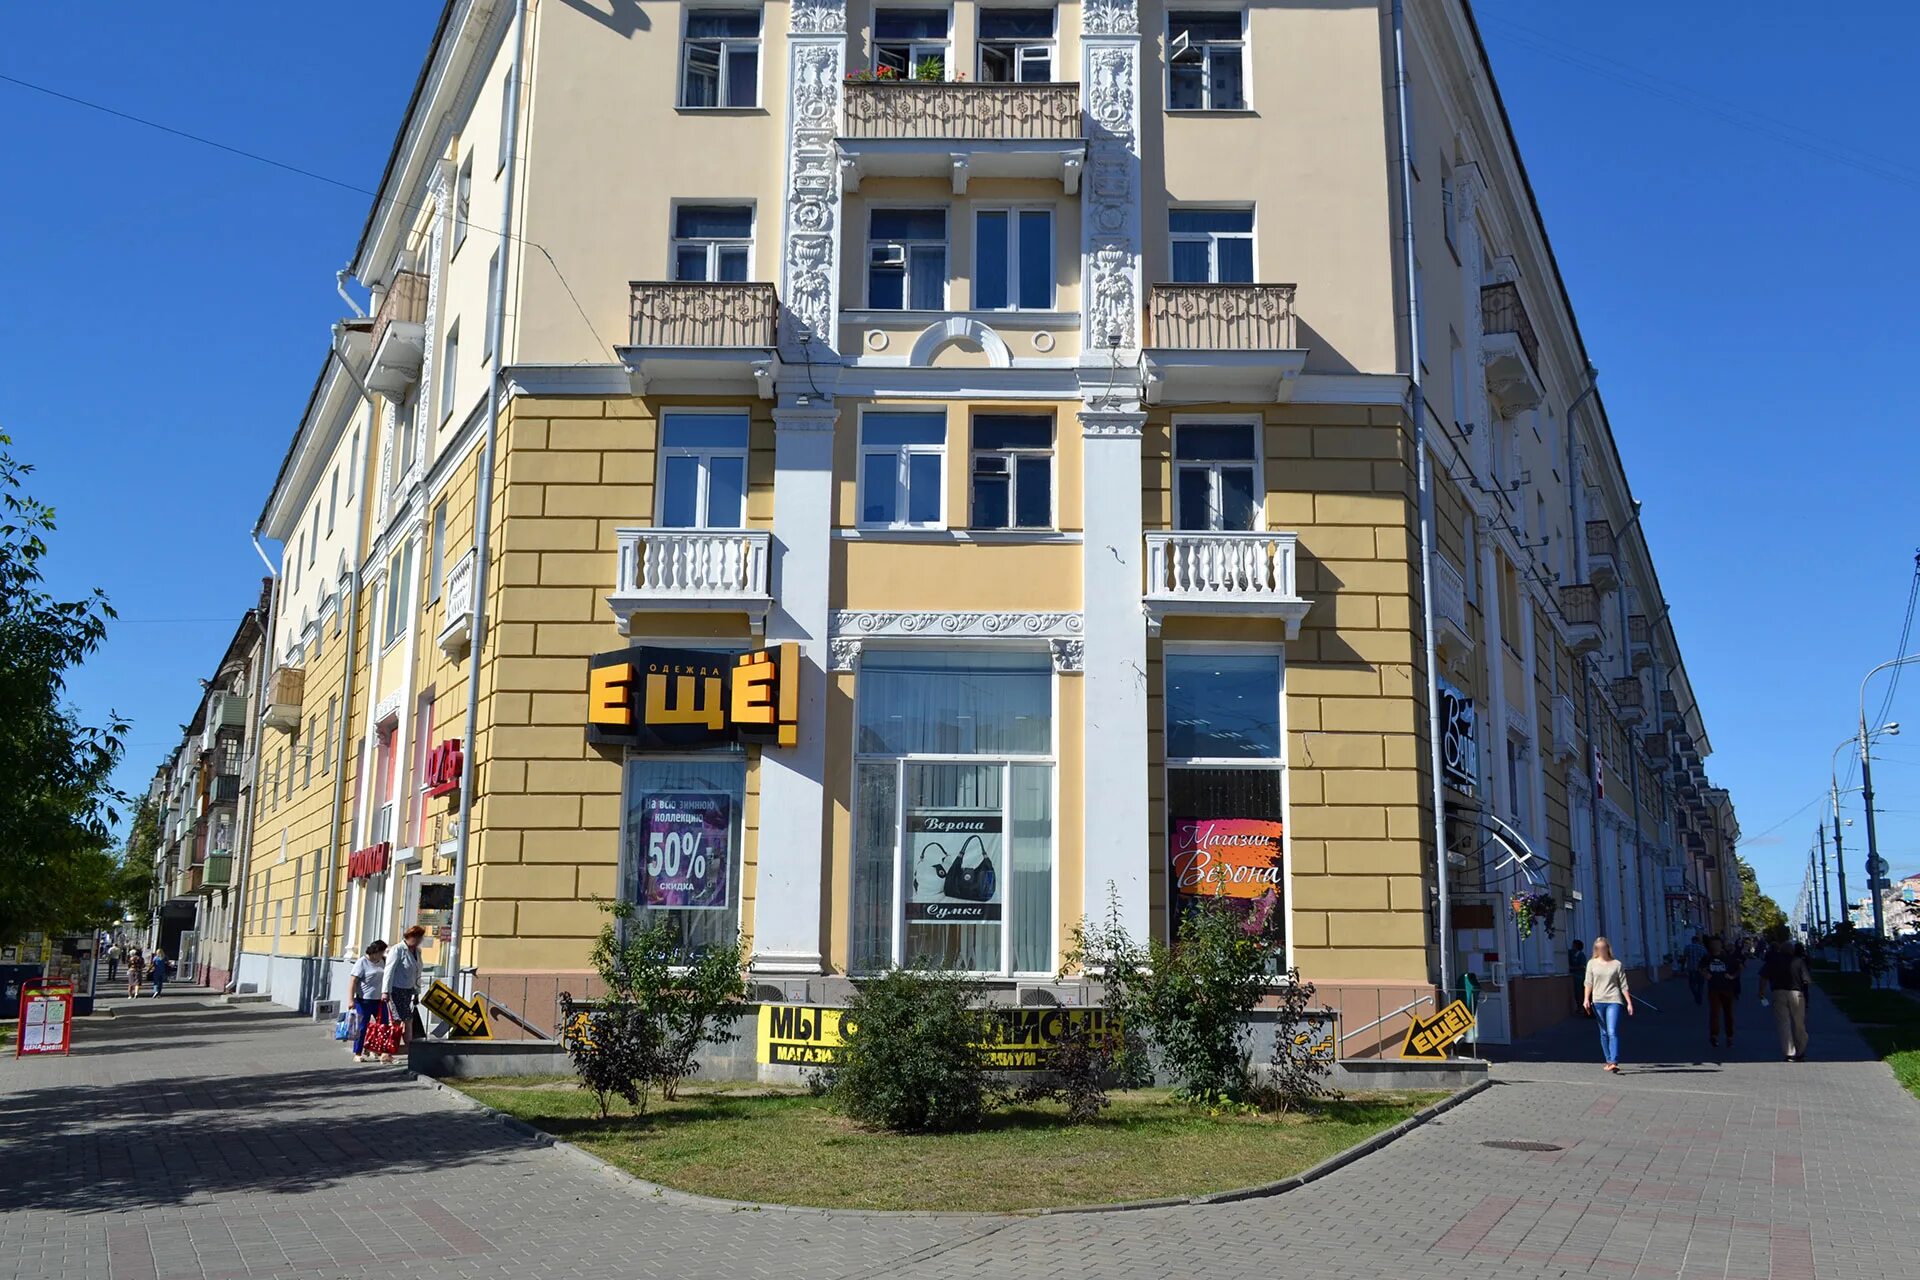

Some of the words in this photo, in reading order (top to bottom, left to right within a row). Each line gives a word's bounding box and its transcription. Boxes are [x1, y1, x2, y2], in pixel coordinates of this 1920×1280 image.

[649, 663, 719, 676] ОДЕЖДА
[588, 642, 799, 747] ЕЩЁ!
[645, 799, 656, 809] На
[679, 800, 715, 810] зимнюю
[655, 813, 704, 824] коллекцию
[924, 817, 985, 832] Верона
[1179, 823, 1270, 850] Магазин
[647, 831, 706, 879] 50%
[1172, 849, 1281, 898] Верона
[926, 903, 983, 919] Сумки
[428, 988, 484, 1036] ЕЩЁ!
[769, 1007, 822, 1041] МЫ
[1410, 1005, 1470, 1055] ЕЩЁ!
